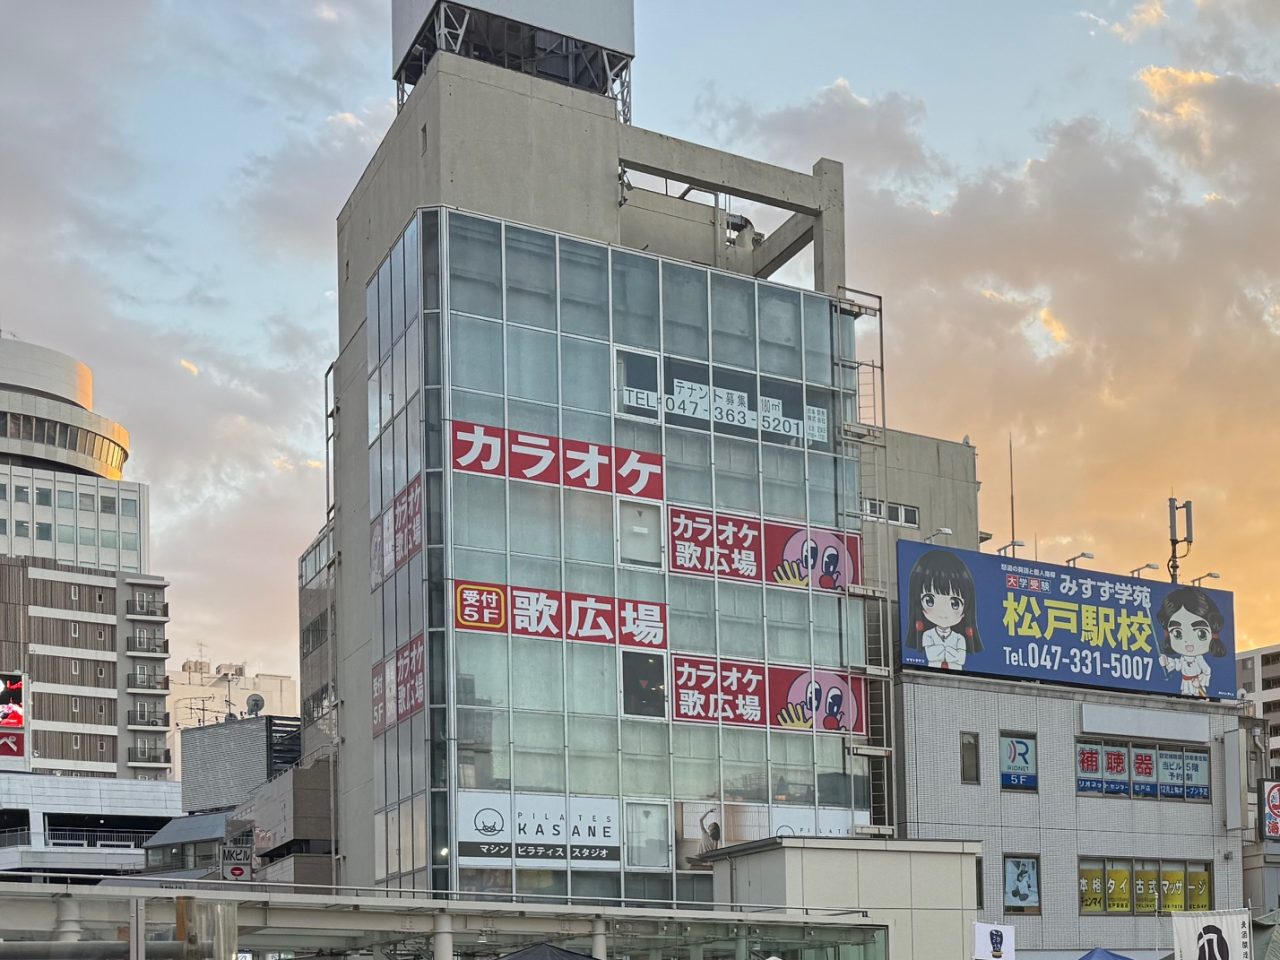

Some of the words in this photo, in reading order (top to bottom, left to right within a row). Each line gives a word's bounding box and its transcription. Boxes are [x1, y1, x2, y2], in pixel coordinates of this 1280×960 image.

[675, 381, 747, 408] テナント募集
[456, 425, 661, 494] カラオケ
[672, 514, 759, 549] カラオケ
[675, 540, 757, 577] 歌広場
[1008, 575, 1050, 592] 大学受験
[1060, 574, 1151, 609] みすず学苑
[462, 590, 498, 606] 受付
[463, 606, 499, 623] 5F
[513, 590, 664, 644] 歌広場
[1003, 592, 1152, 653] 松戸駅校
[676, 662, 763, 693] カラオケ
[373, 702, 383, 725] 5F
[679, 689, 761, 722] 歌広場
[1079, 749, 1153, 777] 補聴器
[1011, 775, 1027, 784] 5F
[518, 812, 612, 823] PILATES
[518, 822, 612, 839] KASANE
[799, 827, 850, 835] PILATE
[222, 849, 250, 862] MKビル
[479, 843, 508, 855] マシン
[518, 846, 564, 857] ピラティス
[572, 847, 608, 858] スタジオ
